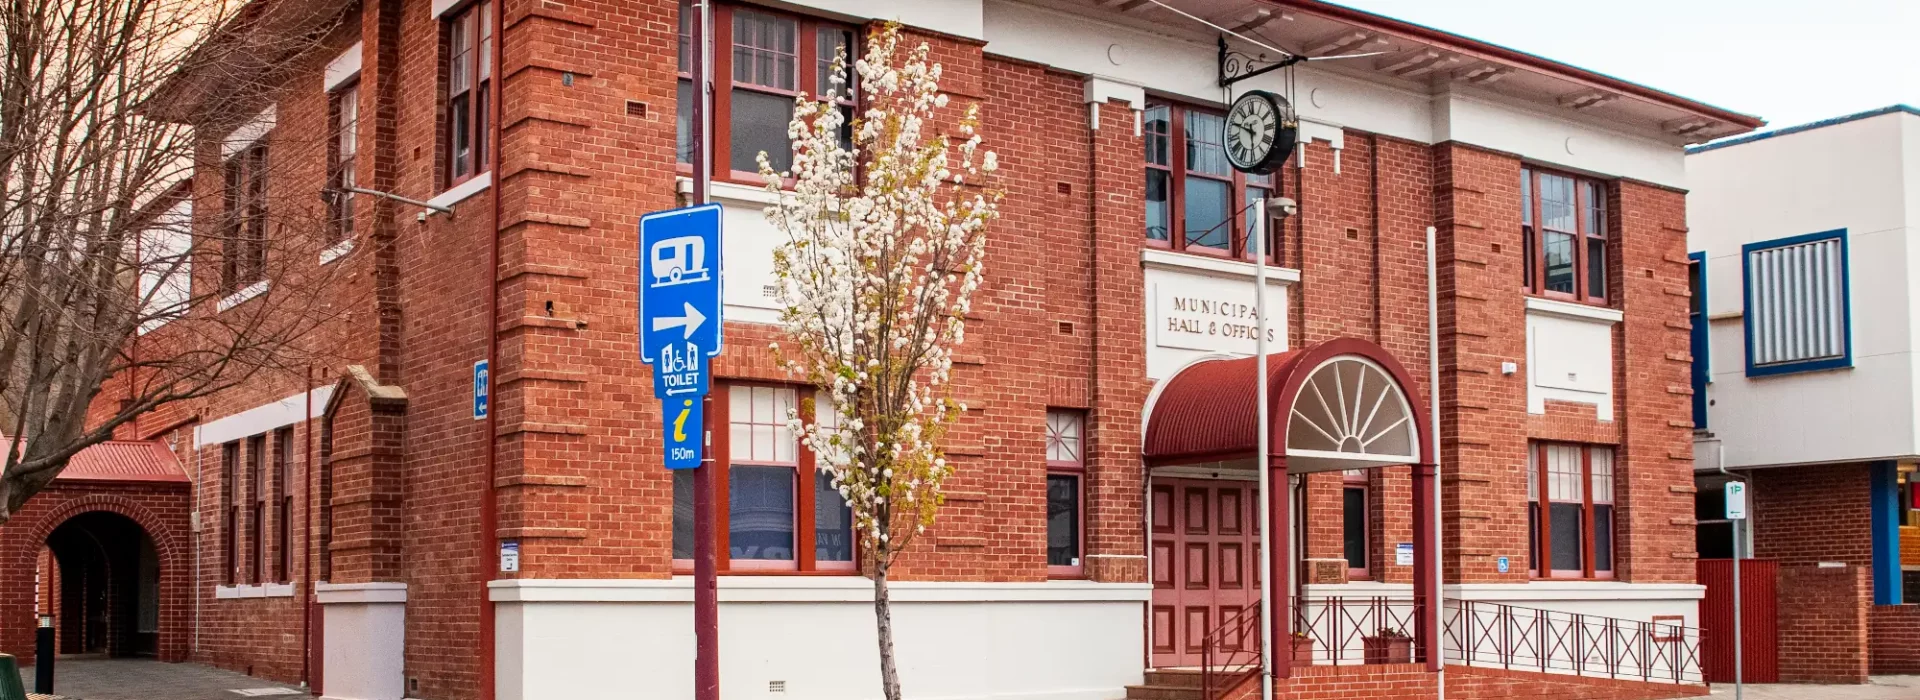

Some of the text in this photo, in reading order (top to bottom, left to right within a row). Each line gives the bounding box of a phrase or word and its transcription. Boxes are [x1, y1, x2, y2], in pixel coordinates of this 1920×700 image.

[1174, 297, 1268, 321] MUNICIPA
[1168, 317, 1274, 342] HALL & OFFICS
[662, 372, 699, 387] TOILET
[671, 448, 695, 460] 150m
